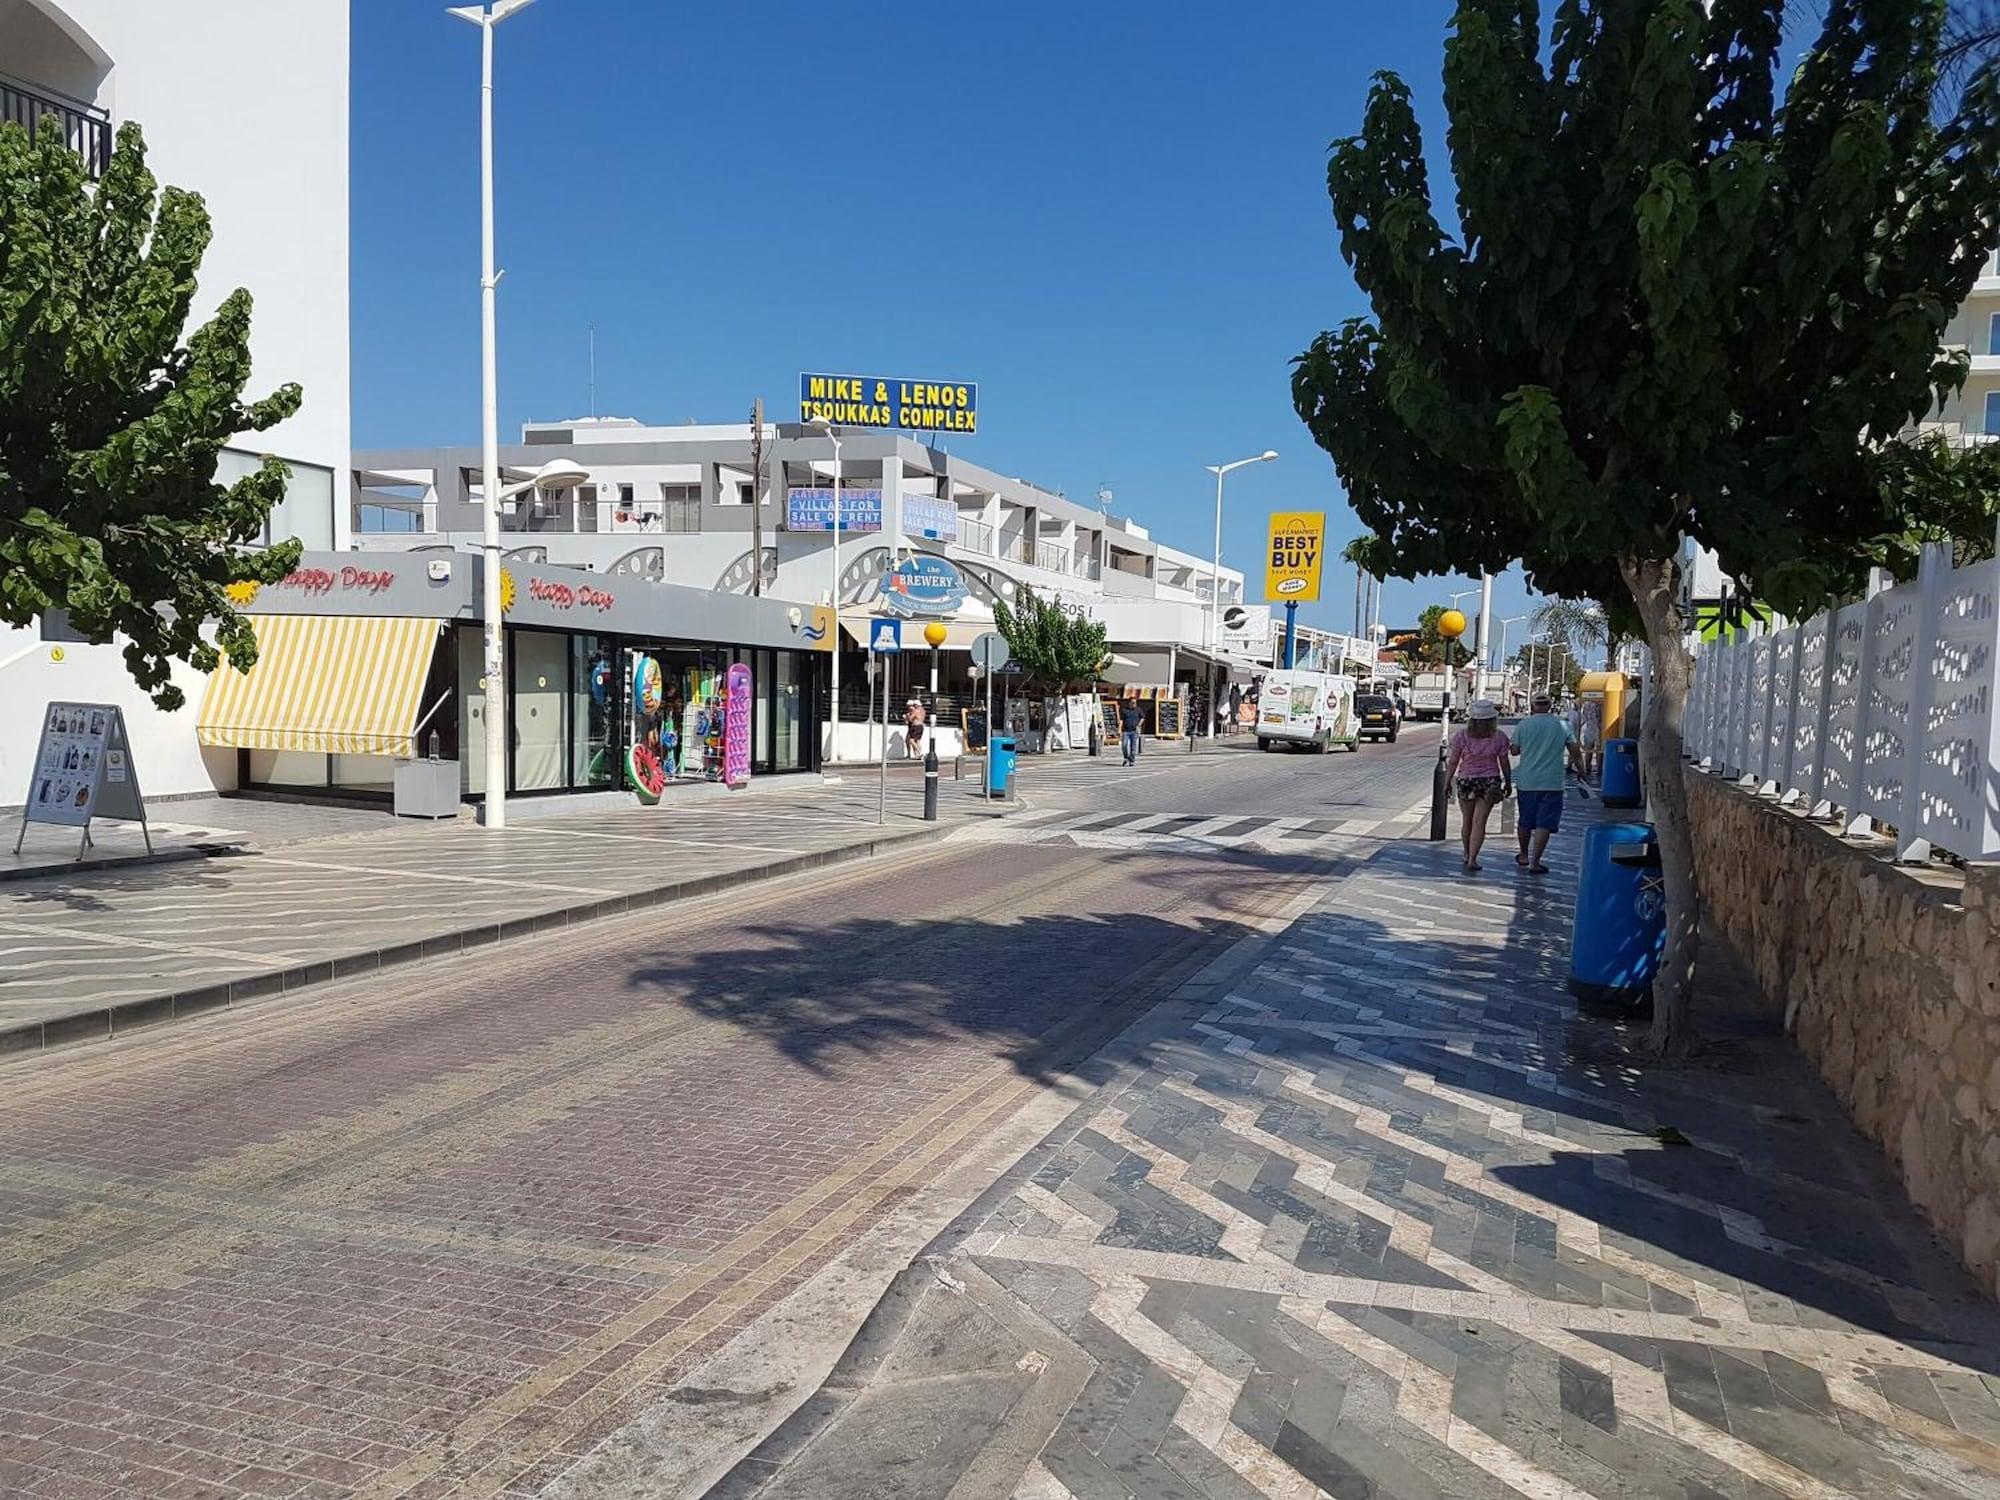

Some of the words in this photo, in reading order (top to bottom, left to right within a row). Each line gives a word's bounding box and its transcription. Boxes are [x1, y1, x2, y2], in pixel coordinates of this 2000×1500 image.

[810, 377, 863, 401] MIKE
[875, 382, 888, 402] &
[901, 383, 968, 407] LENOS
[802, 400, 891, 425] TSOUKKAS
[900, 407, 976, 429] COMPLEX
[850, 501, 874, 510] FOR
[791, 512, 821, 521] SALE
[849, 512, 880, 522] RENT
[1273, 536, 1318, 550] BEST
[1272, 551, 1316, 568] BUY
[283, 568, 335, 595] appy
[341, 566, 394, 593] Days
[900, 574, 953, 588] BREWERY
[529, 577, 574, 609] Happy
